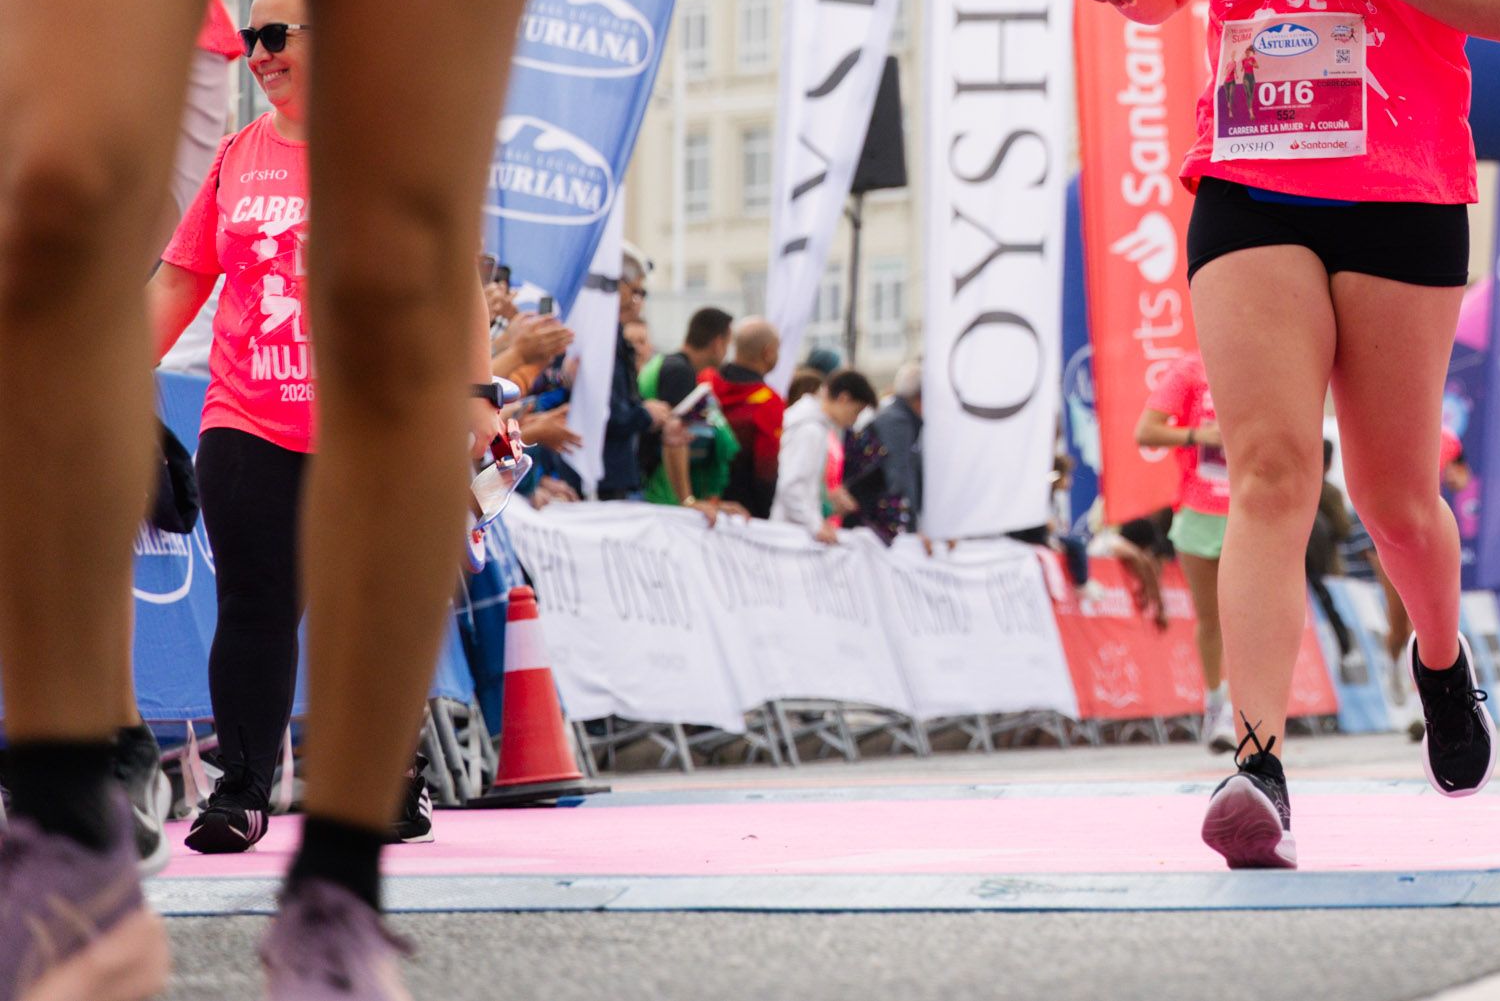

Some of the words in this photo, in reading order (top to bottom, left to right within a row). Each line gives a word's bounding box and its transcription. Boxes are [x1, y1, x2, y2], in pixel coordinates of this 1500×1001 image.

[520, 14, 640, 67] URIANA
[1258, 36, 1314, 50] ASTURIANA
[1258, 80, 1315, 107] 016
[1276, 109, 1296, 121] 552
[1228, 126, 1259, 136] CARRERA
[1260, 124, 1269, 133] DE
[1270, 123, 1279, 132] LA
[1280, 122, 1304, 131] MUJER
[1309, 121, 1316, 130] A
[1317, 118, 1350, 130] CORUÑA
[1230, 140, 1275, 154] OYSHO
[1300, 139, 1348, 150] Santander
[239, 169, 288, 184] OYSHO
[231, 194, 312, 223] CARR
[280, 383, 315, 403] 2026
